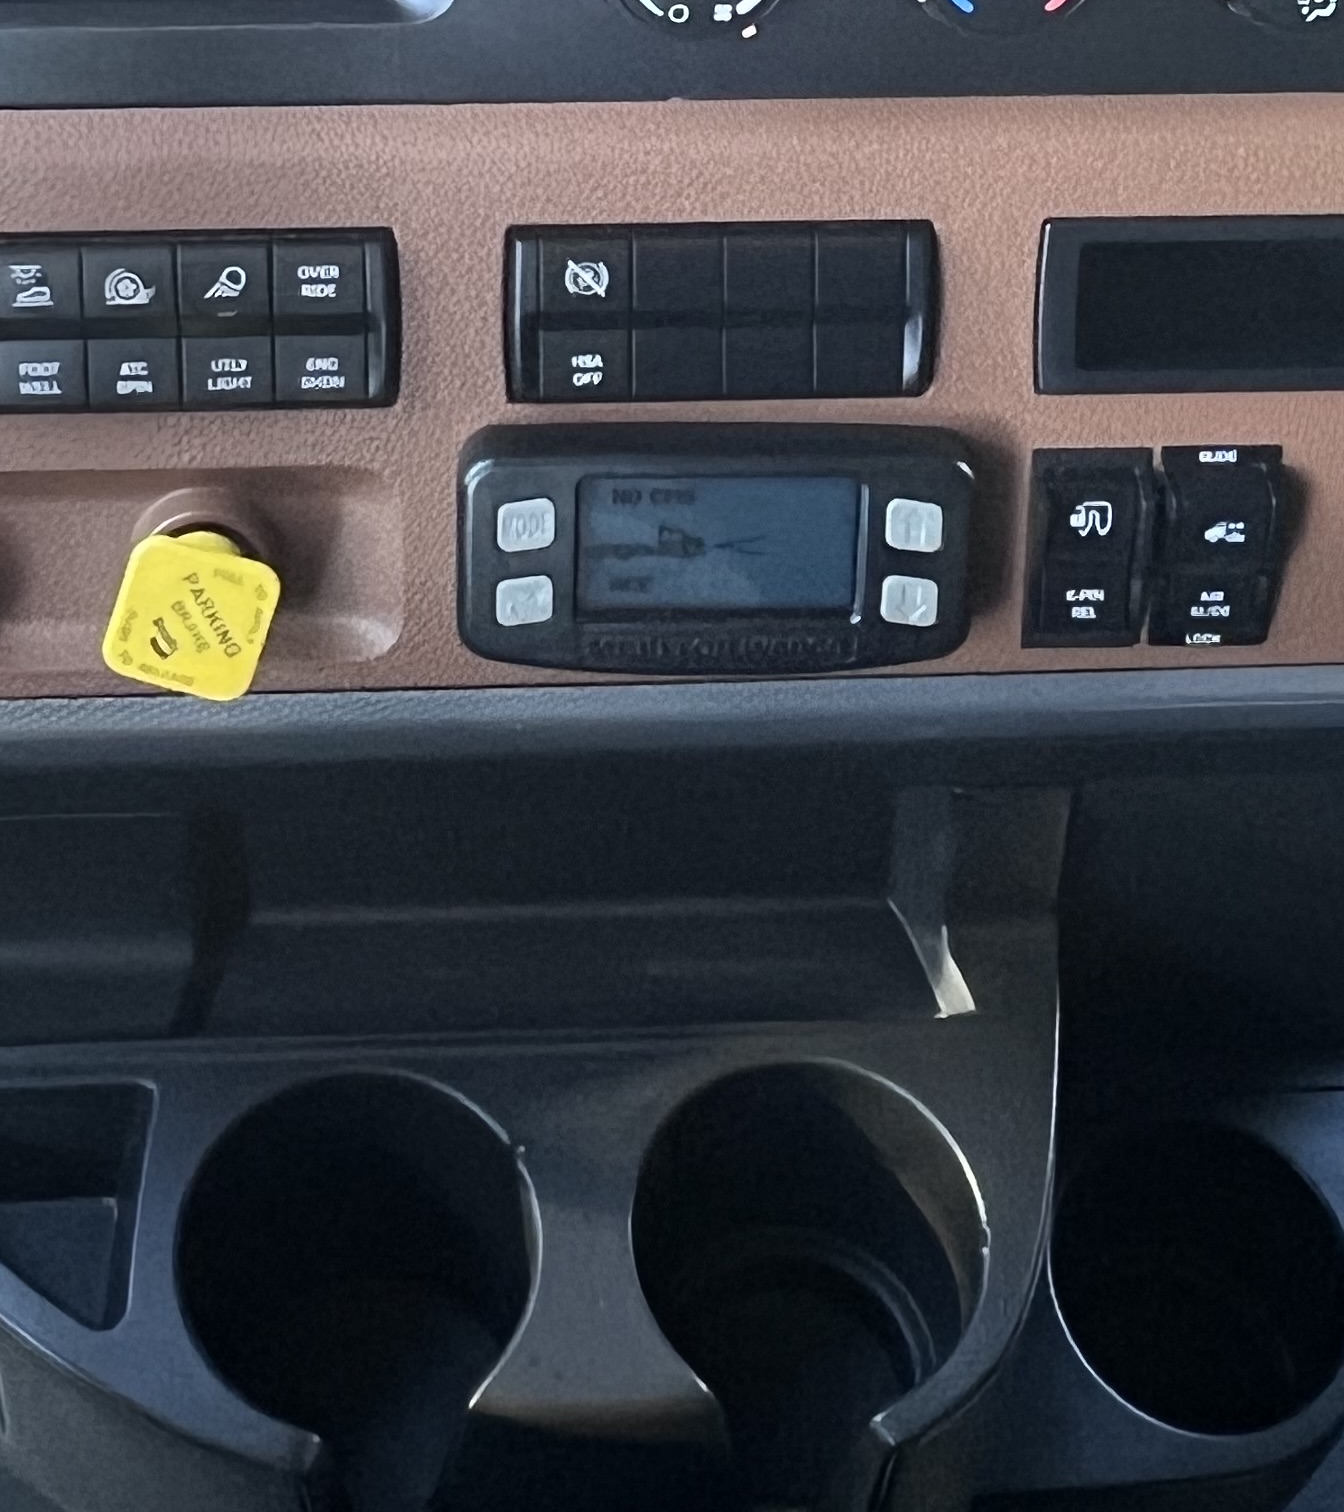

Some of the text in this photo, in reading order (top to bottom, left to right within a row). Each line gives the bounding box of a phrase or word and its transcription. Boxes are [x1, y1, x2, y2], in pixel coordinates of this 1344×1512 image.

[297, 265, 340, 280] OVER
[300, 283, 337, 298] RIDE
[182, 571, 243, 659] PARKING
